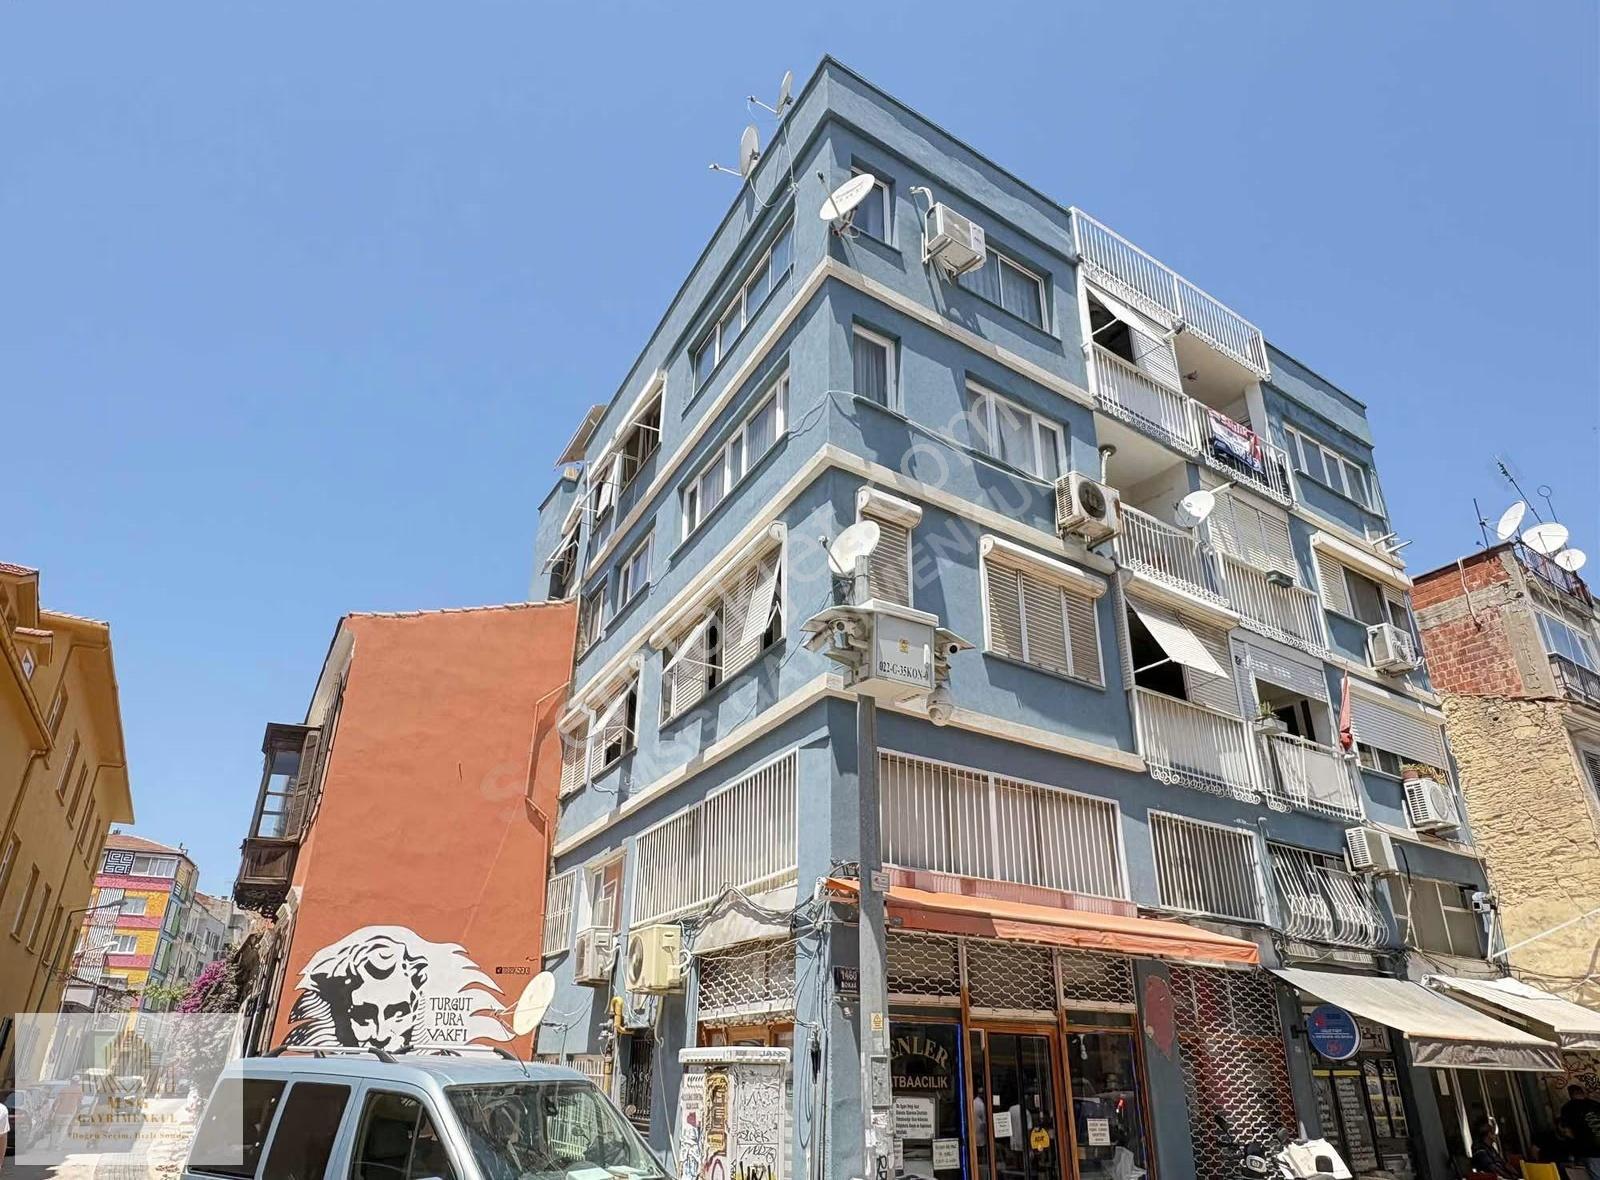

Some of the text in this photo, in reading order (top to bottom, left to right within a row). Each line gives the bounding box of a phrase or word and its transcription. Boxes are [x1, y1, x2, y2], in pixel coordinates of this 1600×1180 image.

[429, 997, 473, 1011] TURGUT
[435, 1012, 464, 1026] PURA
[427, 1029, 467, 1041] VAKFI
[890, 1036, 948, 1070] ENLER
[890, 1075, 948, 1088] TBAACILIK
